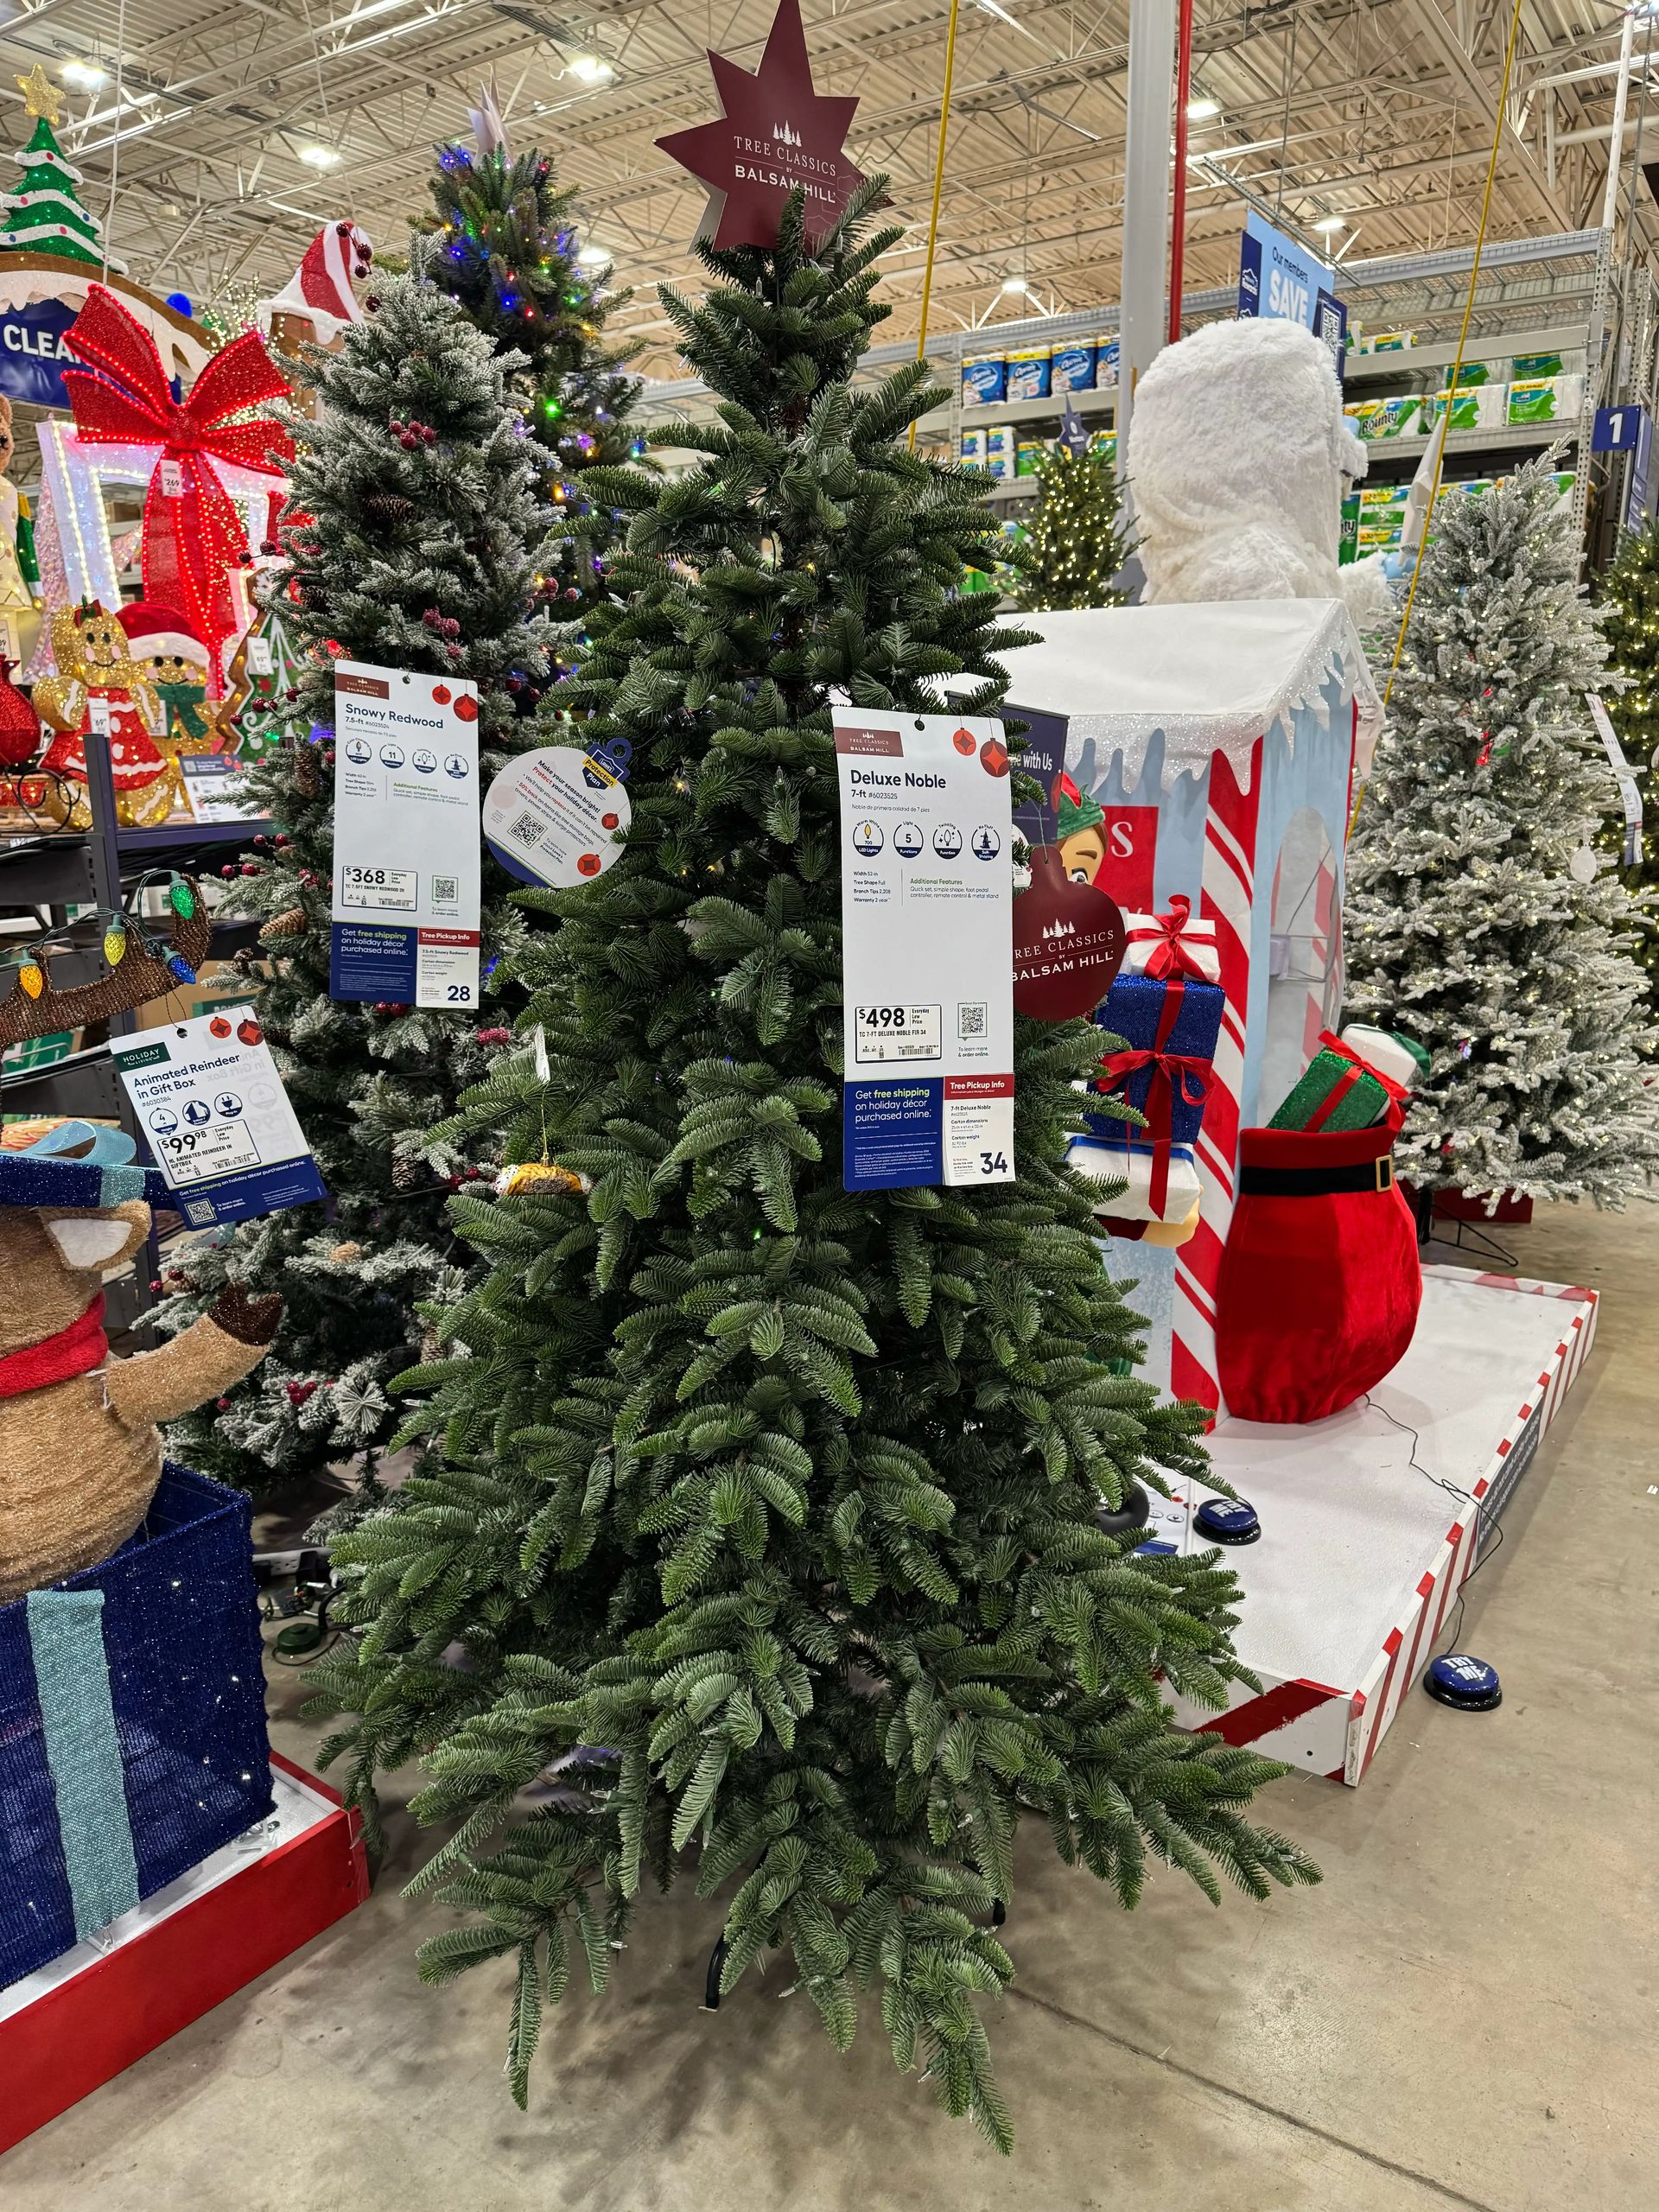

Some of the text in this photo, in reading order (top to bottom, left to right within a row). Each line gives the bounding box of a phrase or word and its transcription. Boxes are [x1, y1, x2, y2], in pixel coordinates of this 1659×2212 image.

[734, 136, 836, 176] TREE CLASSICS
[735, 165, 836, 203] BALSAM HILL
[1272, 247, 1308, 283] Our members
[1269, 270, 1309, 325] SAVE
[3, 324, 82, 364] CLEA
[1362, 411, 1398, 435] Bounty
[1609, 412, 1624, 443] 1
[346, 703, 443, 728] Snowy Redwood
[1023, 750, 1041, 769] with
[1042, 752, 1052, 771] Us
[585, 760, 614, 785] Protection
[587, 772, 601, 786] Plan
[851, 769, 946, 789] Deluxe Noble
[527, 789, 538, 801] back
[532, 766, 553, 785] Protect
[550, 782, 564, 795] your
[563, 791, 582, 810] holiday
[537, 760, 554, 774] Make
[552, 772, 566, 785] your
[564, 781, 583, 799] season
[582, 795, 601, 814] bright!
[543, 789, 553, 798] you
[851, 789, 867, 798] 7-ft
[906, 834, 912, 843] 5
[346, 868, 385, 885] $368
[353, 938, 381, 947] holiday
[375, 932, 407, 941] shipping
[1014, 930, 1114, 959] REE CLASSICS
[341, 946, 382, 955] purchased
[1013, 951, 1114, 982] BALSAM HILL
[448, 985, 471, 1001] 28
[859, 1007, 905, 1028] $498
[123, 1048, 160, 1063] HOLIDAY
[134, 1054, 240, 1088] Animated Reindeer
[137, 1078, 196, 1099] in Gift Box
[855, 1087, 930, 1099] Get free shipping
[142, 1096, 172, 1107] #6030384
[868, 1100, 900, 1110] holiday
[903, 1098, 927, 1108] décor
[855, 1110, 902, 1124] purchased
[176, 1151, 201, 1162] ANIMATED
[201, 1146, 226, 1156] REINDEER
[170, 1160, 192, 1169] GIFTBOX
[980, 1152, 1007, 1174] 34
[200, 1182, 222, 1192] shipping
[228, 1175, 247, 1184] holiday
[262, 1164, 289, 1176] purchased
[1208, 1503, 1235, 1518] ME
[1220, 1500, 1250, 1513] TRY
[1440, 1656, 1475, 1669] TRY
[1455, 1665, 1486, 1681] ME
